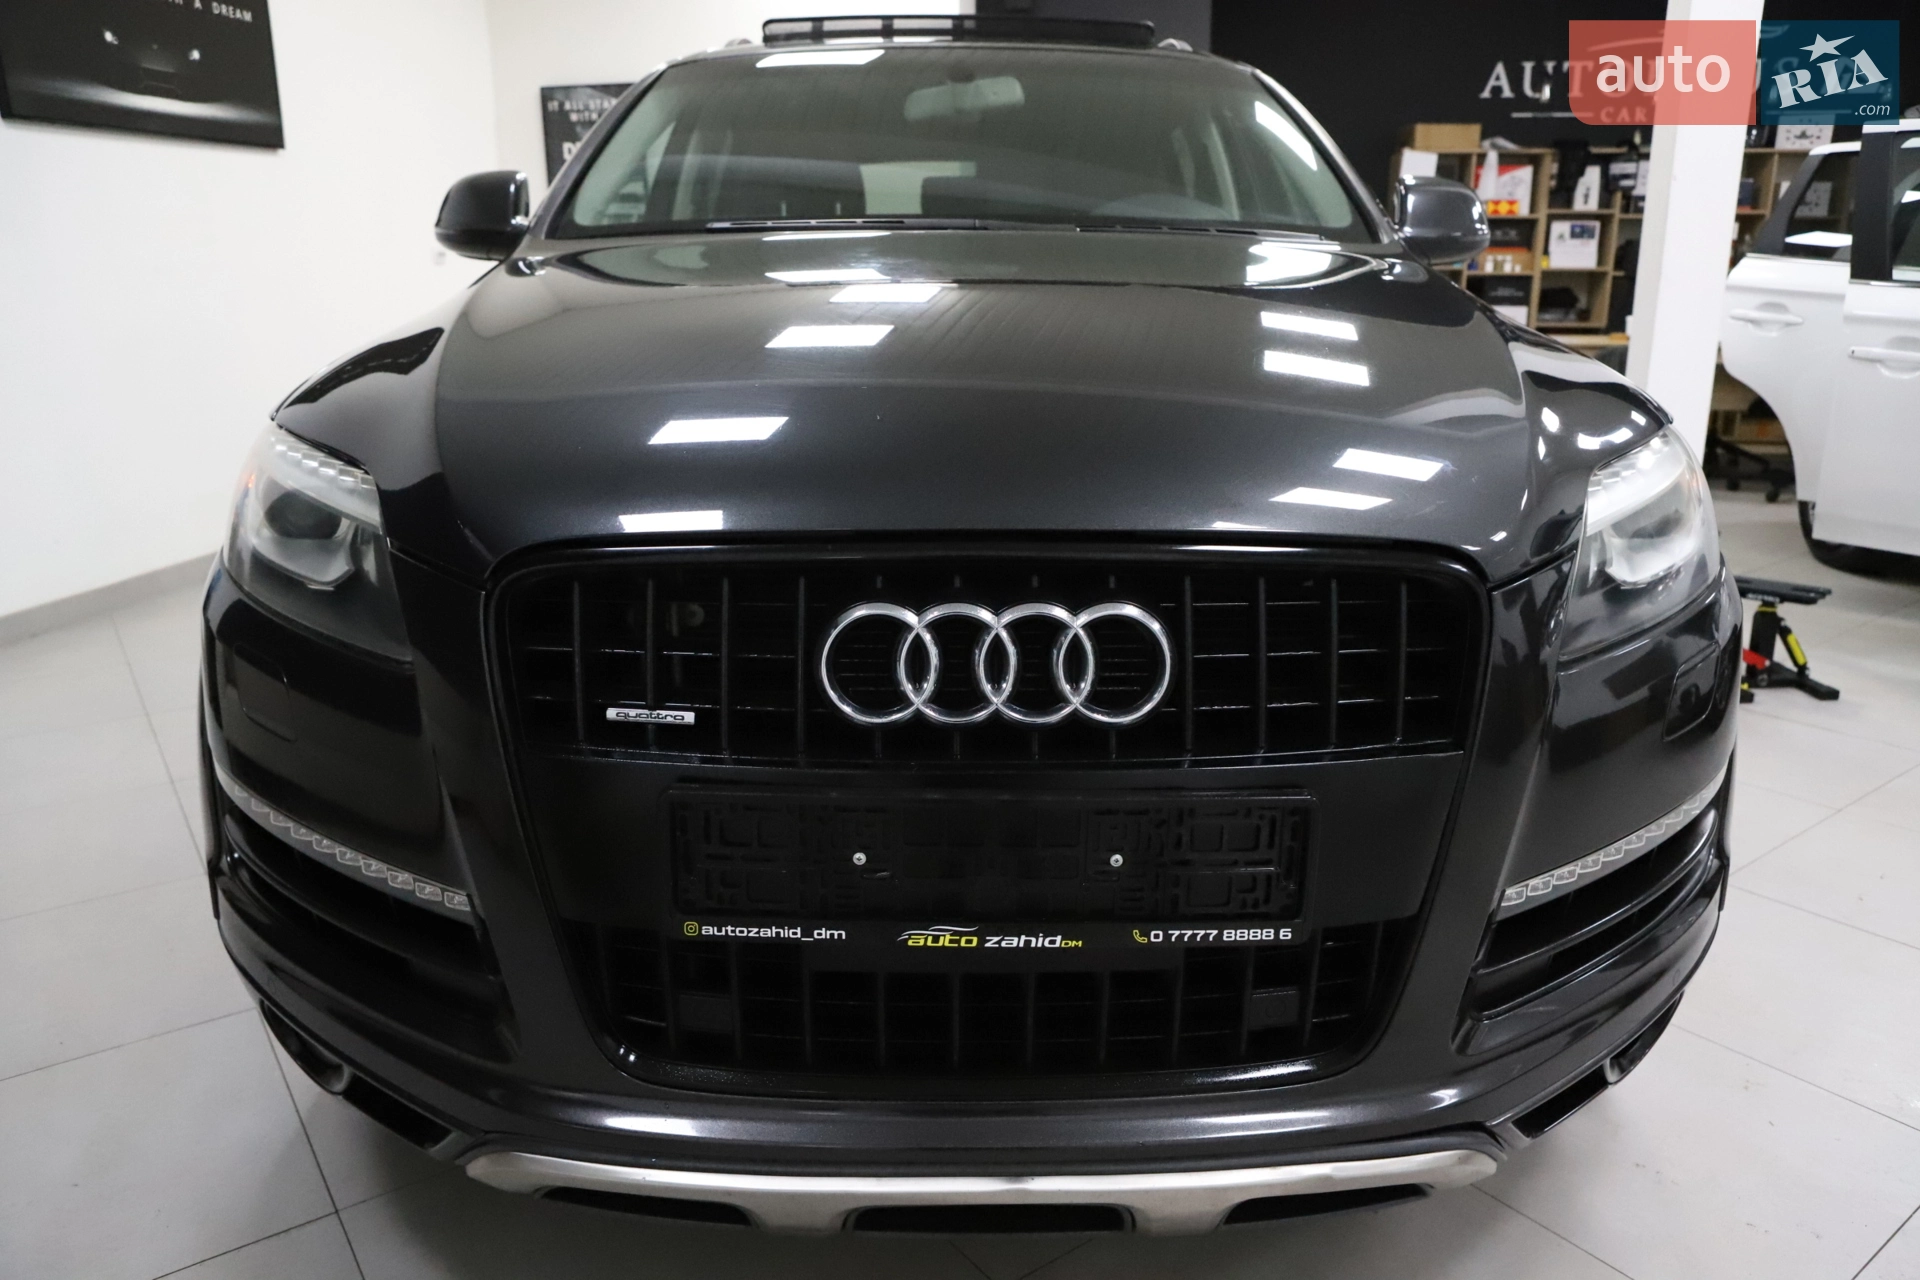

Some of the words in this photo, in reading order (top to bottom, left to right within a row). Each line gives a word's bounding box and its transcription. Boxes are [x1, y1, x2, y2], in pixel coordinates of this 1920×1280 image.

[211, 1, 253, 23] DREAM
[615, 710, 685, 721] quattro
[702, 925, 845, 940] autozahid_dm
[1150, 931, 1163, 942] 0
[1168, 930, 1218, 941] 7777
[1223, 929, 1274, 941] 8888
[1279, 929, 1291, 939] 6
[907, 934, 978, 948] auto
